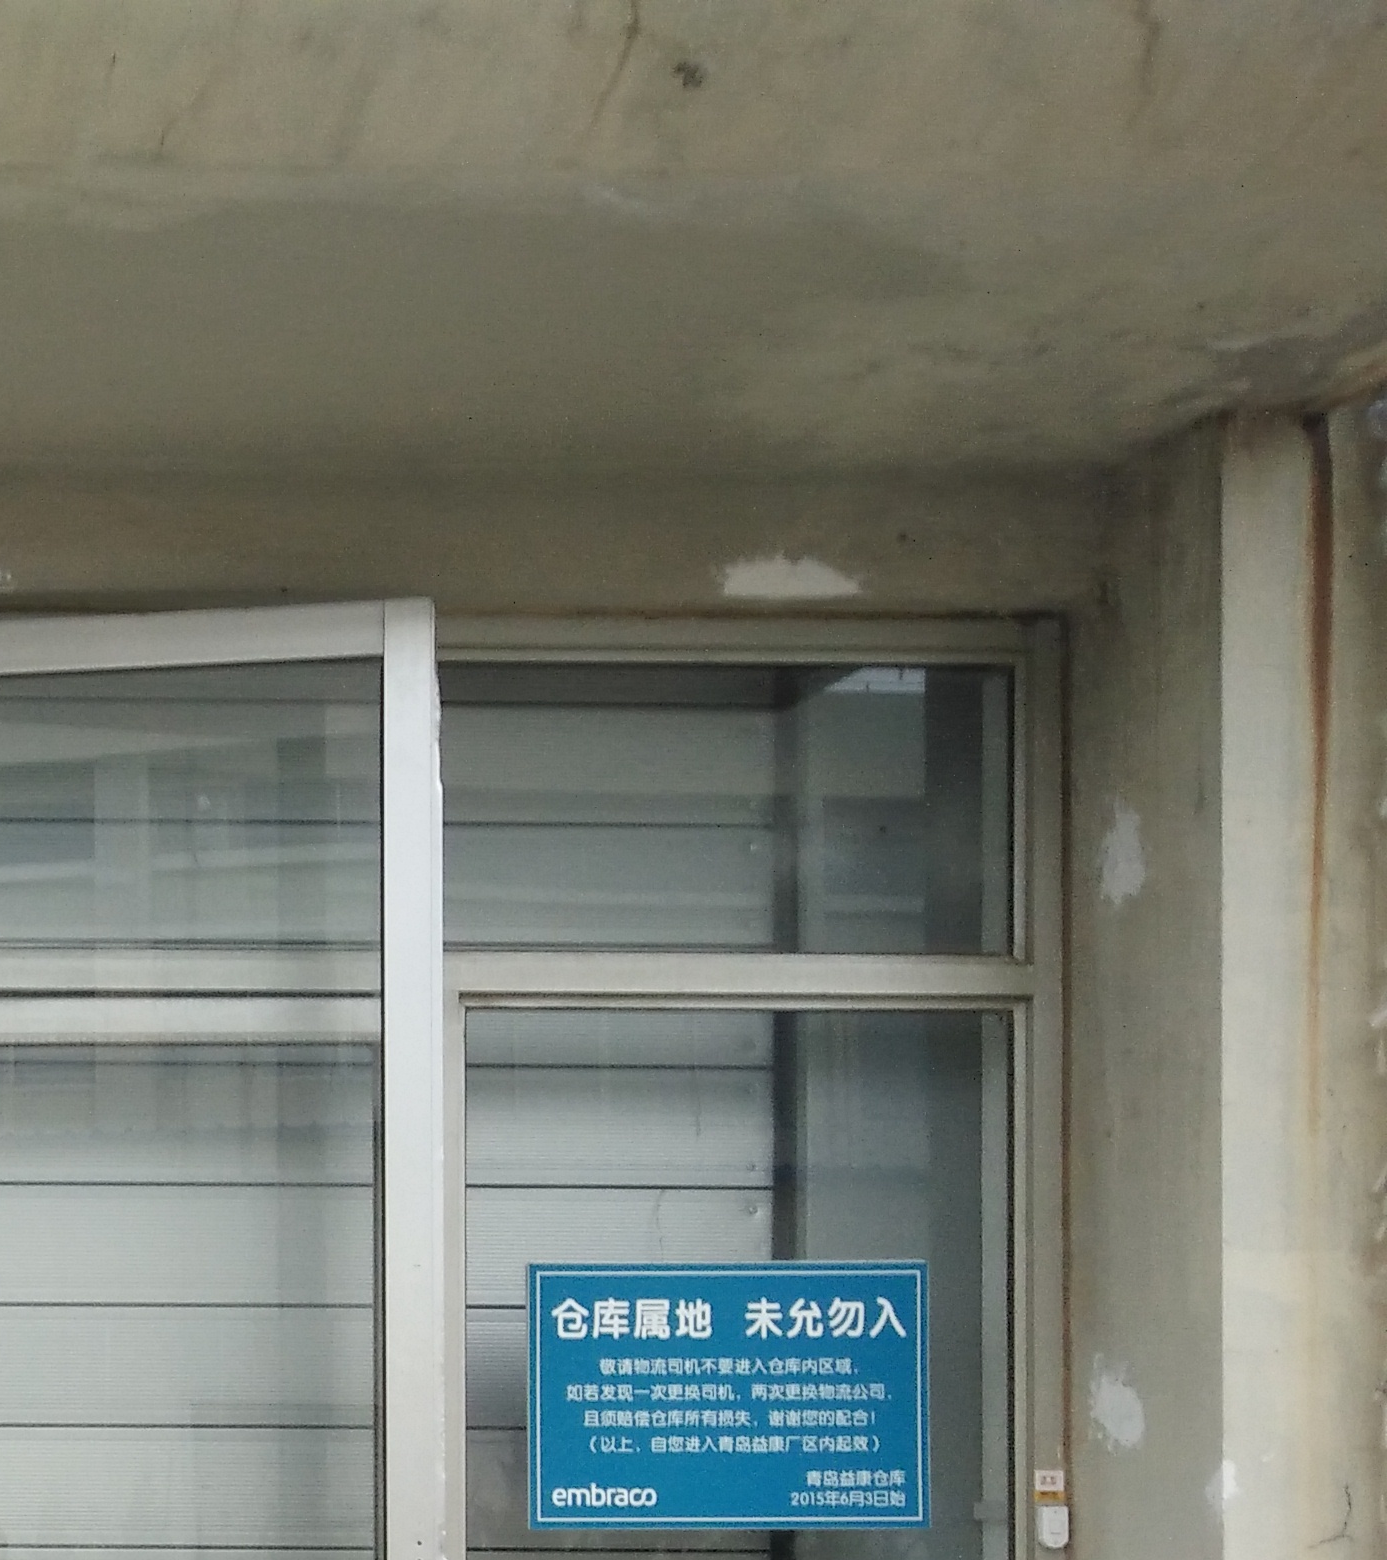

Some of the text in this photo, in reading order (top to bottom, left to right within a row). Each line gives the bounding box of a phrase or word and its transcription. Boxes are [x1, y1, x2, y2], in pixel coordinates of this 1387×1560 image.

[551, 1297, 908, 1340] 仓库属地 未允勿入
[807, 1469, 907, 1487] 青岛益康仓库
[551, 1482, 658, 1507] embraco
[790, 1490, 907, 1508] 2015年6月3日始
